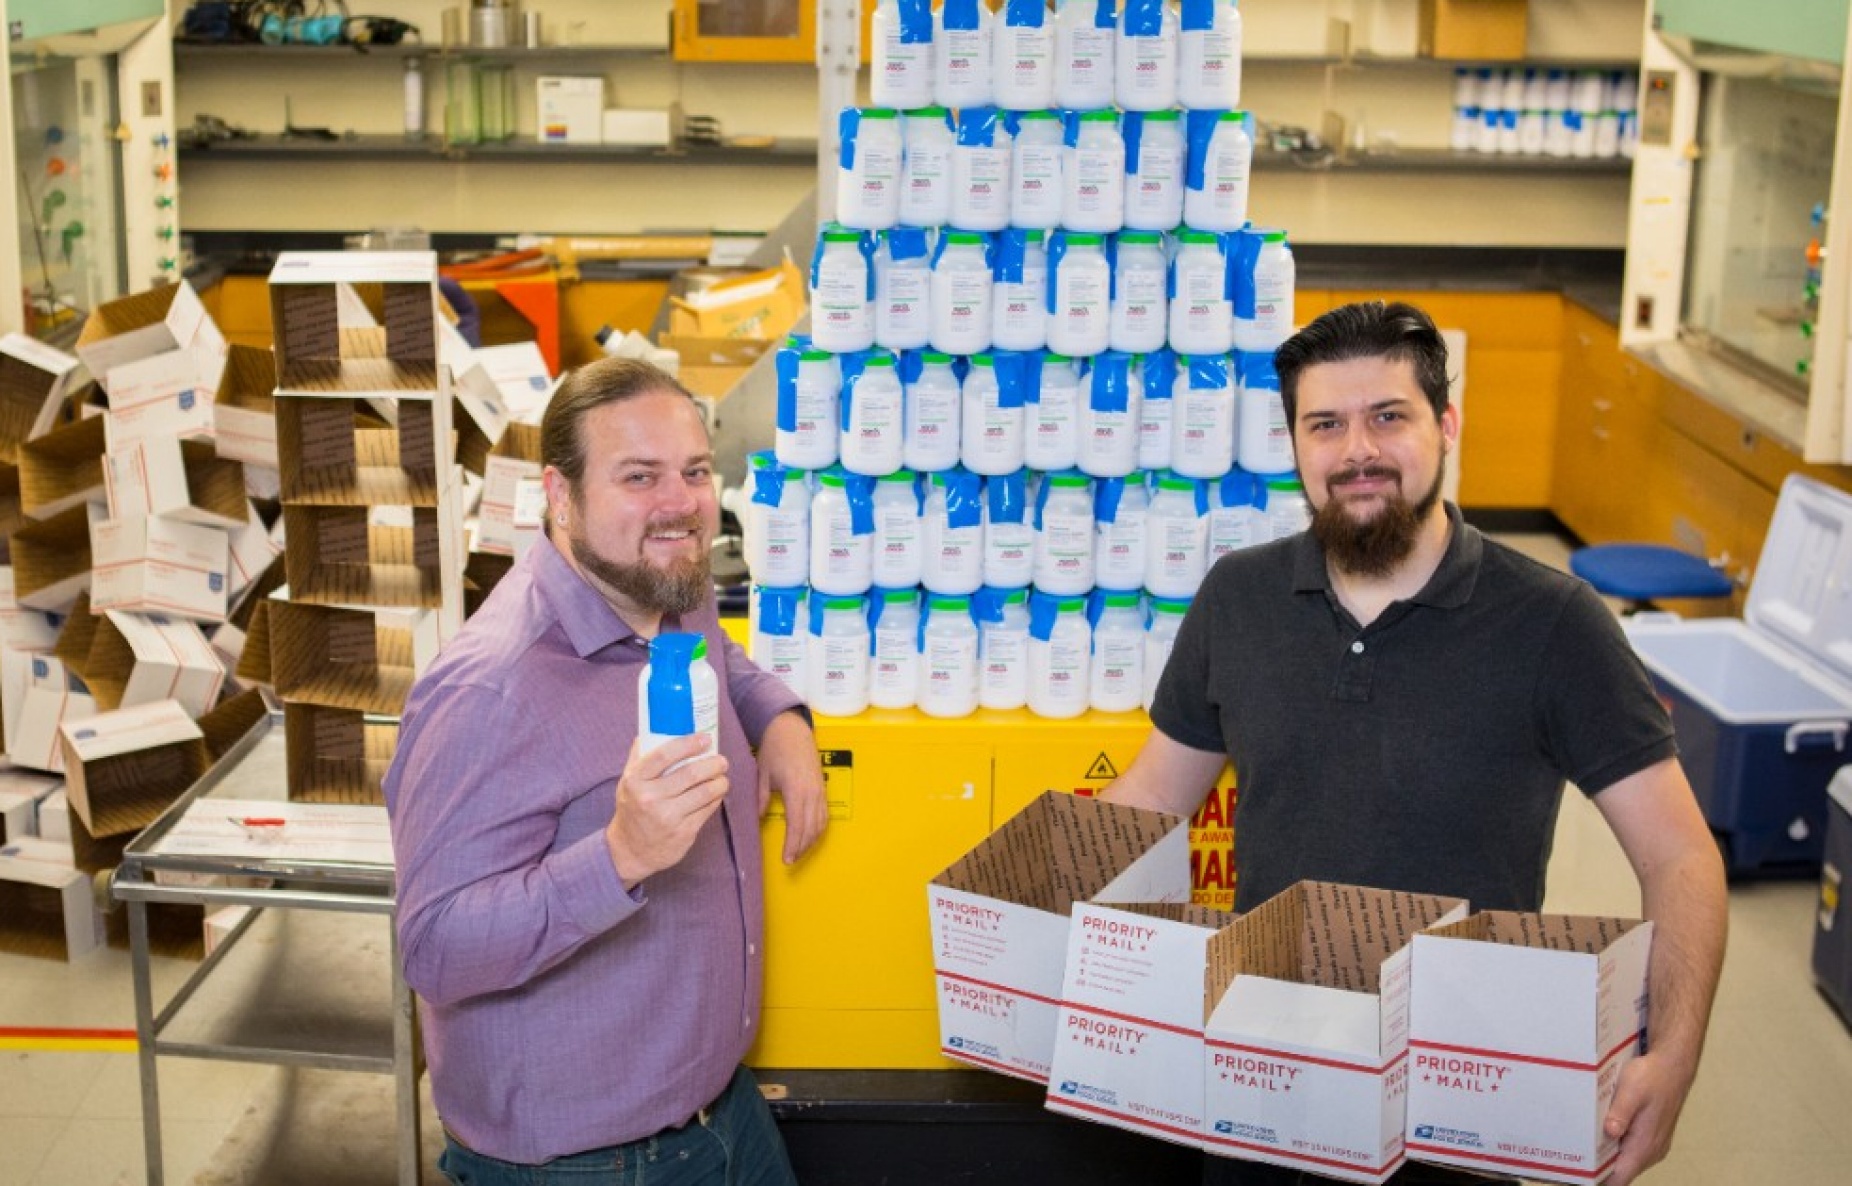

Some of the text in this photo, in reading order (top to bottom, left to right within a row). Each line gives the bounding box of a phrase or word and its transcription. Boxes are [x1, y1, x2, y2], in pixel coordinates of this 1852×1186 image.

[937, 898, 1002, 922] PRIORITY
[953, 913, 988, 931] MAIL
[1083, 915, 1155, 941] PRIORITY
[1098, 935, 1133, 951] MAIL
[944, 981, 1013, 1009] PRIORITY
[961, 999, 997, 1017] MAIL
[1068, 1015, 1145, 1044] PRIORITY
[1084, 1036, 1123, 1054] MAIL
[1214, 1053, 1297, 1080] PRIORITY
[1416, 1055, 1506, 1080] PRIORITY
[1233, 1072, 1277, 1091] MAIL
[1437, 1074, 1483, 1093] MAIL
